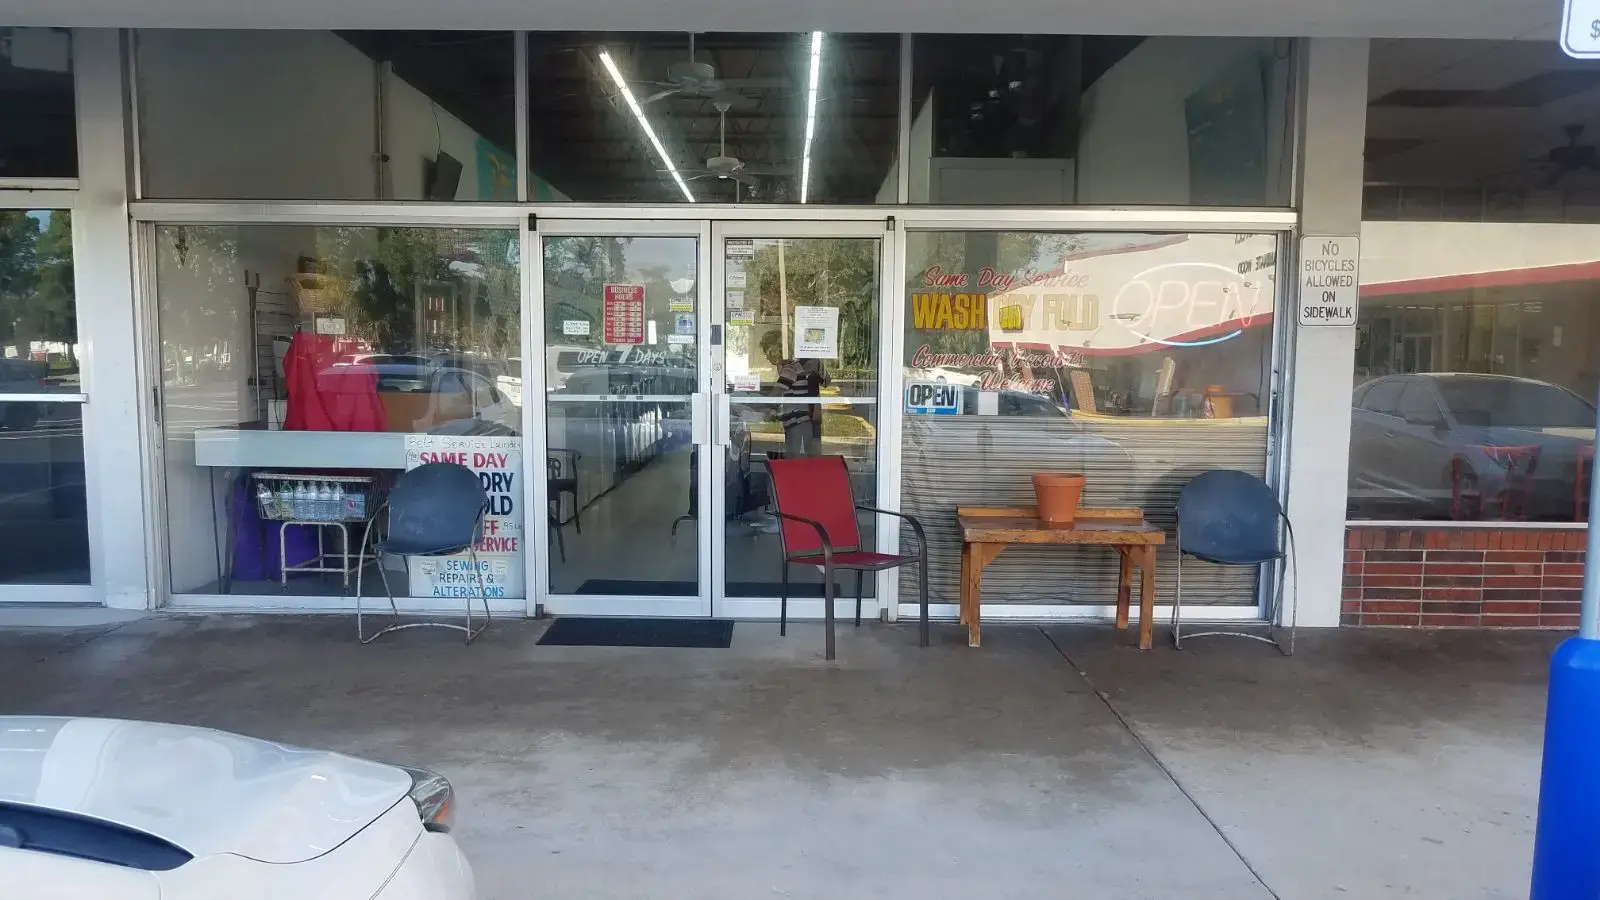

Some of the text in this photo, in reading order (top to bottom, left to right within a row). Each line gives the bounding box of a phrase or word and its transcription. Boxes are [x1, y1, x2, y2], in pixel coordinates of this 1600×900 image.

[1321, 243, 1340, 256] NO
[1304, 259, 1355, 272] BICYCLES
[923, 265, 1091, 292] Same Day Service
[1305, 275, 1353, 288] ALLOWED
[611, 286, 638, 294] BUSINESS
[1321, 290, 1336, 303] ON
[1112, 279, 1261, 328] OPEN
[912, 293, 988, 331] WASH
[1041, 293, 1101, 331] FOLD
[1303, 306, 1353, 318] SIDEWALK
[577, 345, 668, 364] OPEN 7 DAYS
[912, 344, 1088, 370] Commercial Accounts
[977, 370, 1056, 395] Welcome
[910, 384, 956, 407] OPEN
[420, 452, 468, 468] SAME
[473, 452, 508, 468] DAY
[479, 472, 514, 492] DRY
[446, 560, 489, 571] SEWING
[439, 573, 494, 584] REPAIRS &
[433, 585, 504, 597] ALTERATIONS
